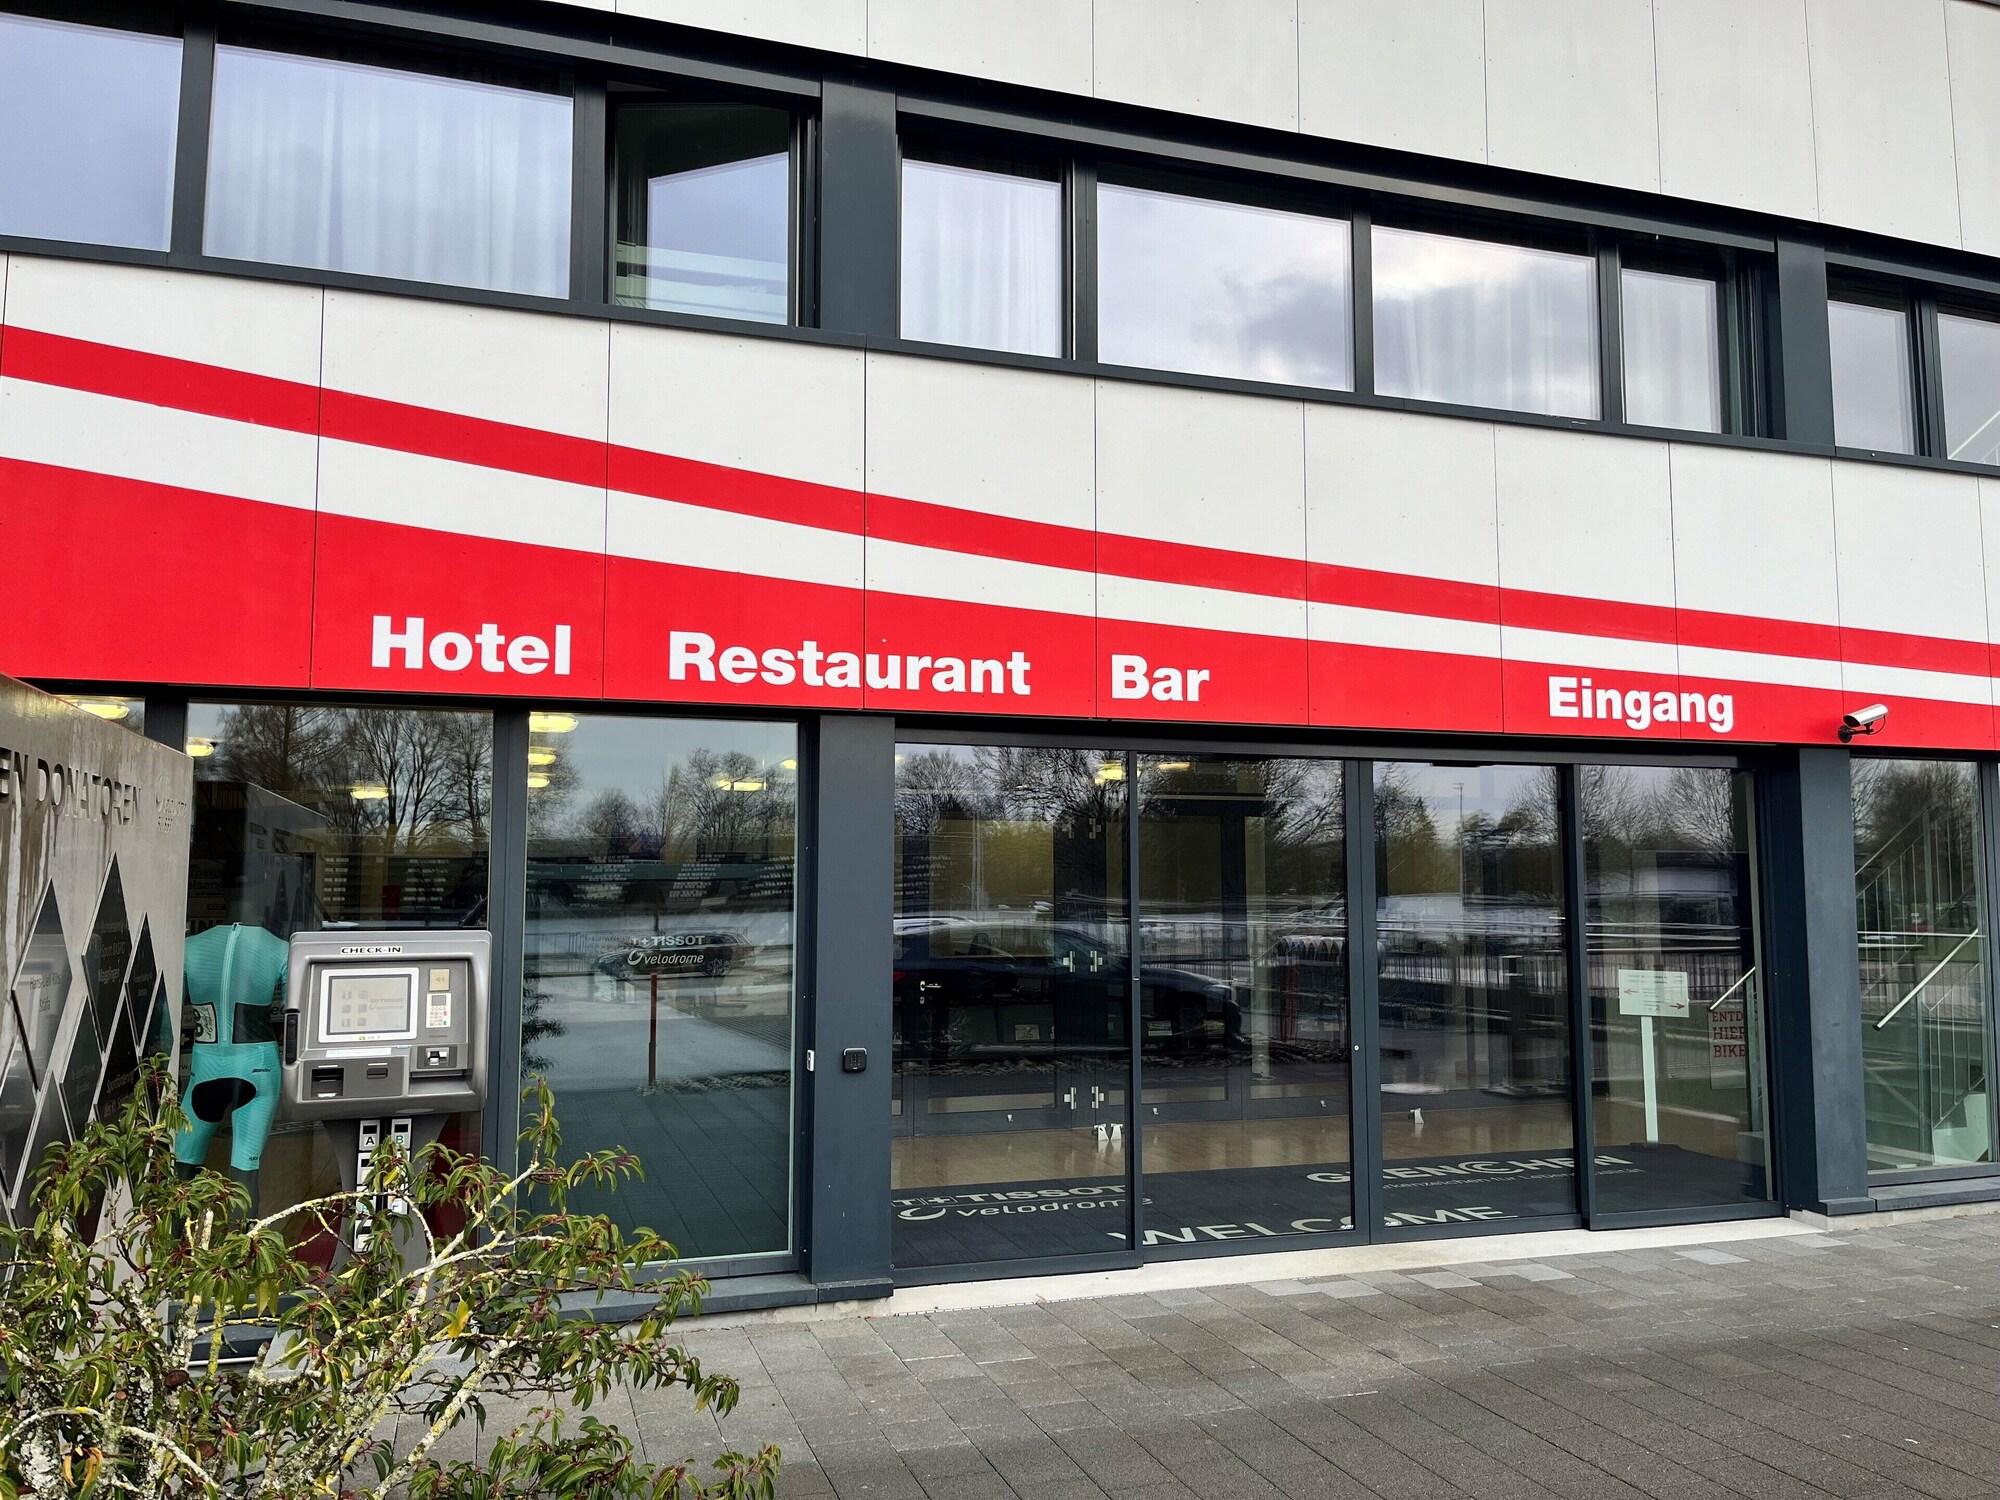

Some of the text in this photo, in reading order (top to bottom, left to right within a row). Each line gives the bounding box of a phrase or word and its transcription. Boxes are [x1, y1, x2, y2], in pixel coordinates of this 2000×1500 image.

[372, 615, 1733, 733] Hotel Restaurant Bar Eingang
[36, 758, 142, 825] DONATOREN
[651, 935, 705, 946] TISSOT
[341, 946, 401, 954] CHECK-IN
[644, 953, 704, 965] velodrome
[366, 1136, 375, 1145] A
[395, 1135, 404, 1144] B
[956, 1185, 1125, 1203] TISSOT
